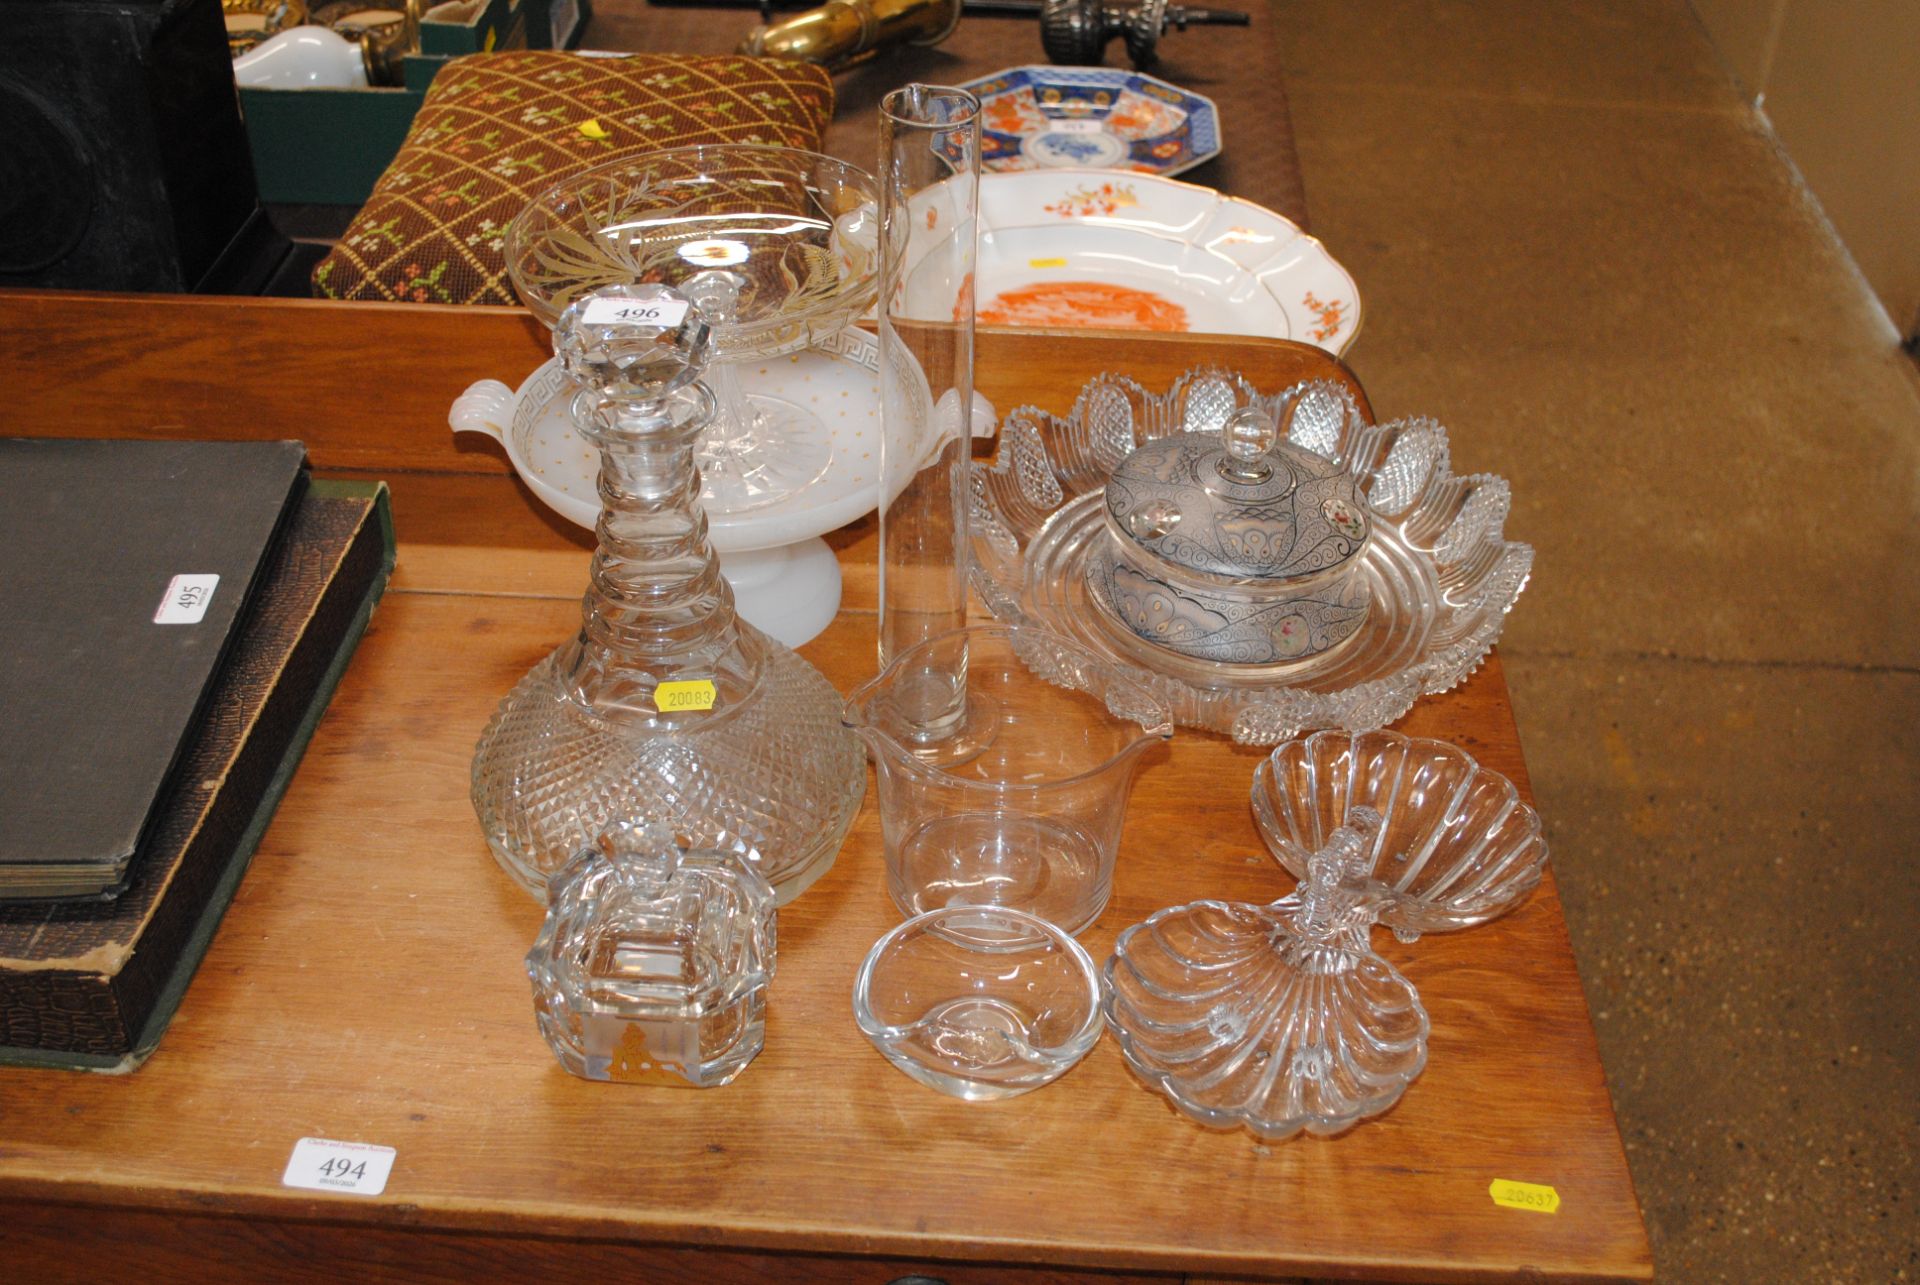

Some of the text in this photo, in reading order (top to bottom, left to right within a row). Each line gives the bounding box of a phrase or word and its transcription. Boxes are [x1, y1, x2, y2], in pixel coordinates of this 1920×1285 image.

[615, 307, 661, 319] 496
[178, 586, 202, 609] 495
[669, 691, 711, 706] 20083
[319, 1157, 367, 1180] 494
[1506, 1189, 1552, 1206] 20637
